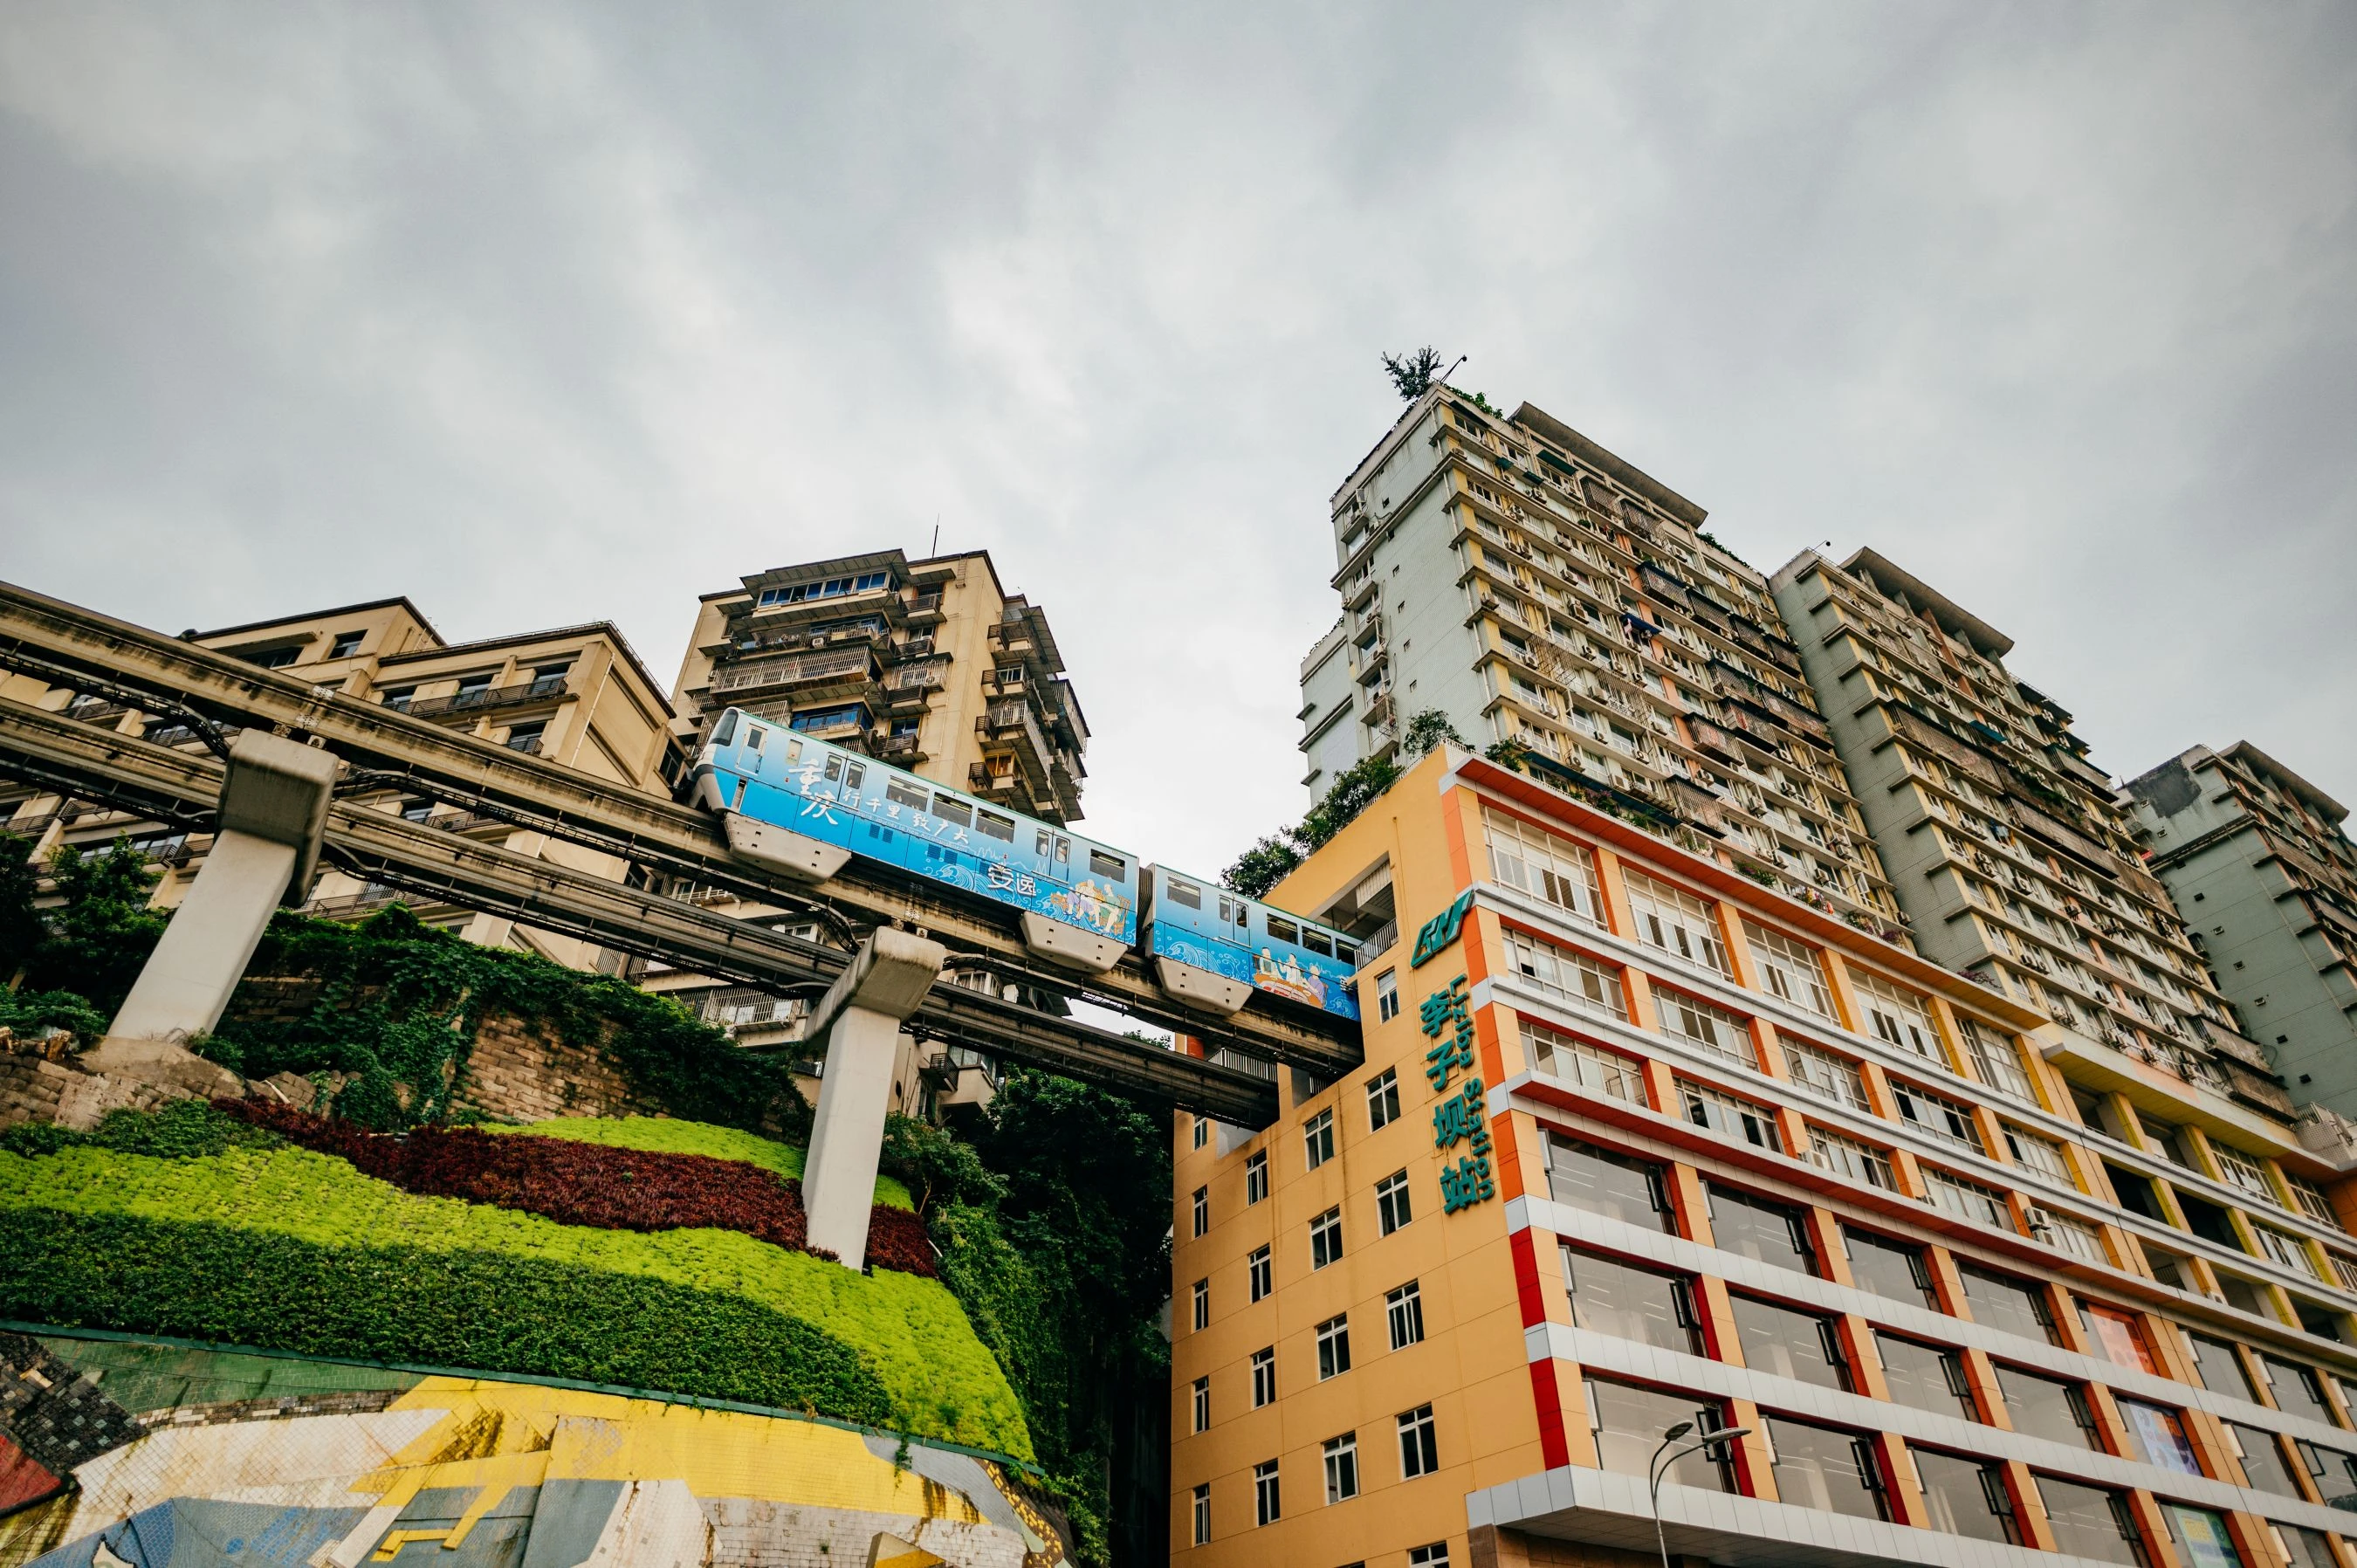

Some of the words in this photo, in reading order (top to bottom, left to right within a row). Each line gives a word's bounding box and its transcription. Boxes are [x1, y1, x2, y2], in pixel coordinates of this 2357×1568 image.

[787, 758, 838, 825] 重庆
[988, 862, 1037, 897] 安逸
[1419, 988, 1480, 1214] 李子坝站
[1449, 973, 1474, 1069] Liziba
[1464, 1077, 1495, 1201] Station
